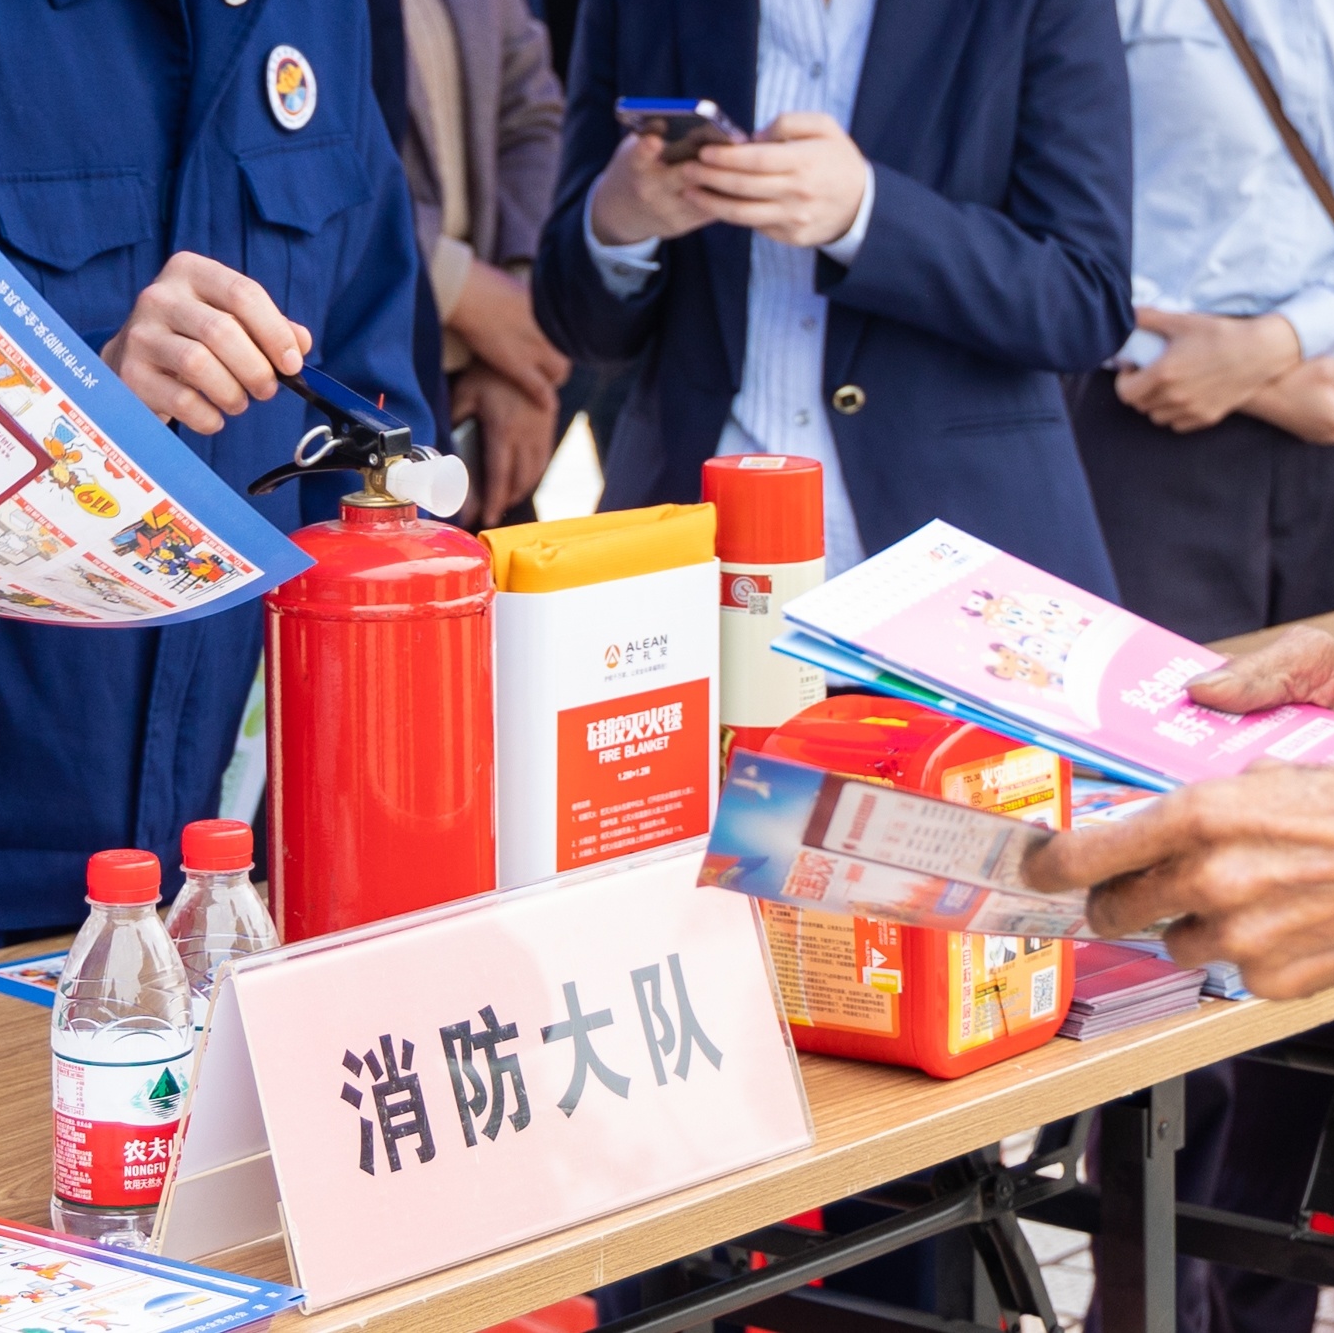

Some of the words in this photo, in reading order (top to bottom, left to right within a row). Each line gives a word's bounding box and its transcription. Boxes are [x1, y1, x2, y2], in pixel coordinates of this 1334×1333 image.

[78, 488, 114, 515] 119
[625, 634, 668, 653] ALEAN
[587, 702, 683, 752] 硅胶灭火毯
[599, 745, 621, 765] FIRE
[624, 736, 670, 760] BLANKET
[339, 952, 724, 1177] 消防大队
[123, 1162, 166, 1177] NONGFU
